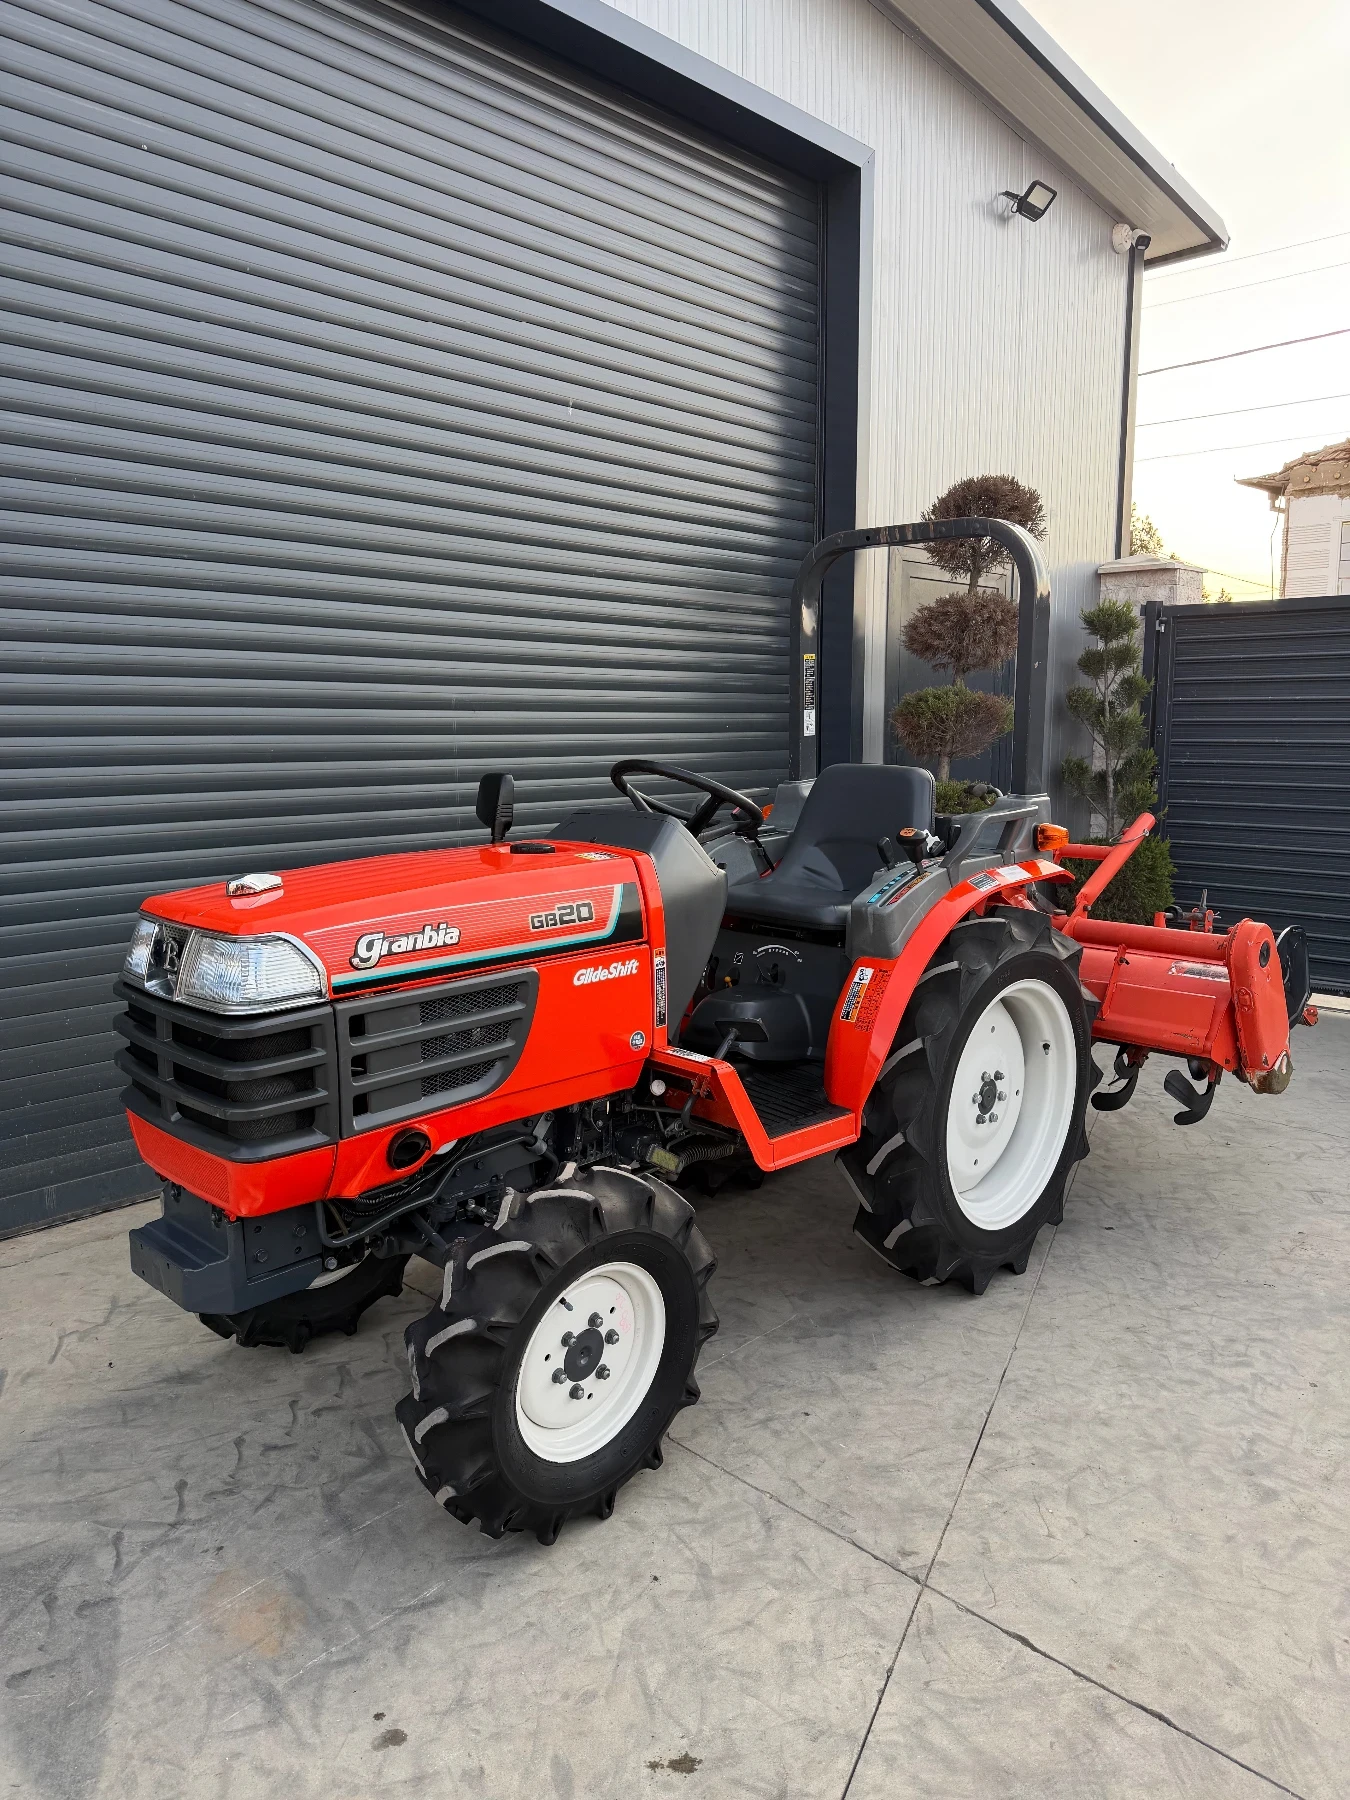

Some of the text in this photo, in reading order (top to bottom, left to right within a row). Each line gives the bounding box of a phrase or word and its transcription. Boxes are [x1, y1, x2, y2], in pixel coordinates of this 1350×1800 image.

[530, 902, 594, 931] GB20
[350, 922, 461, 970] Granbia
[573, 959, 639, 986] GlideShift
